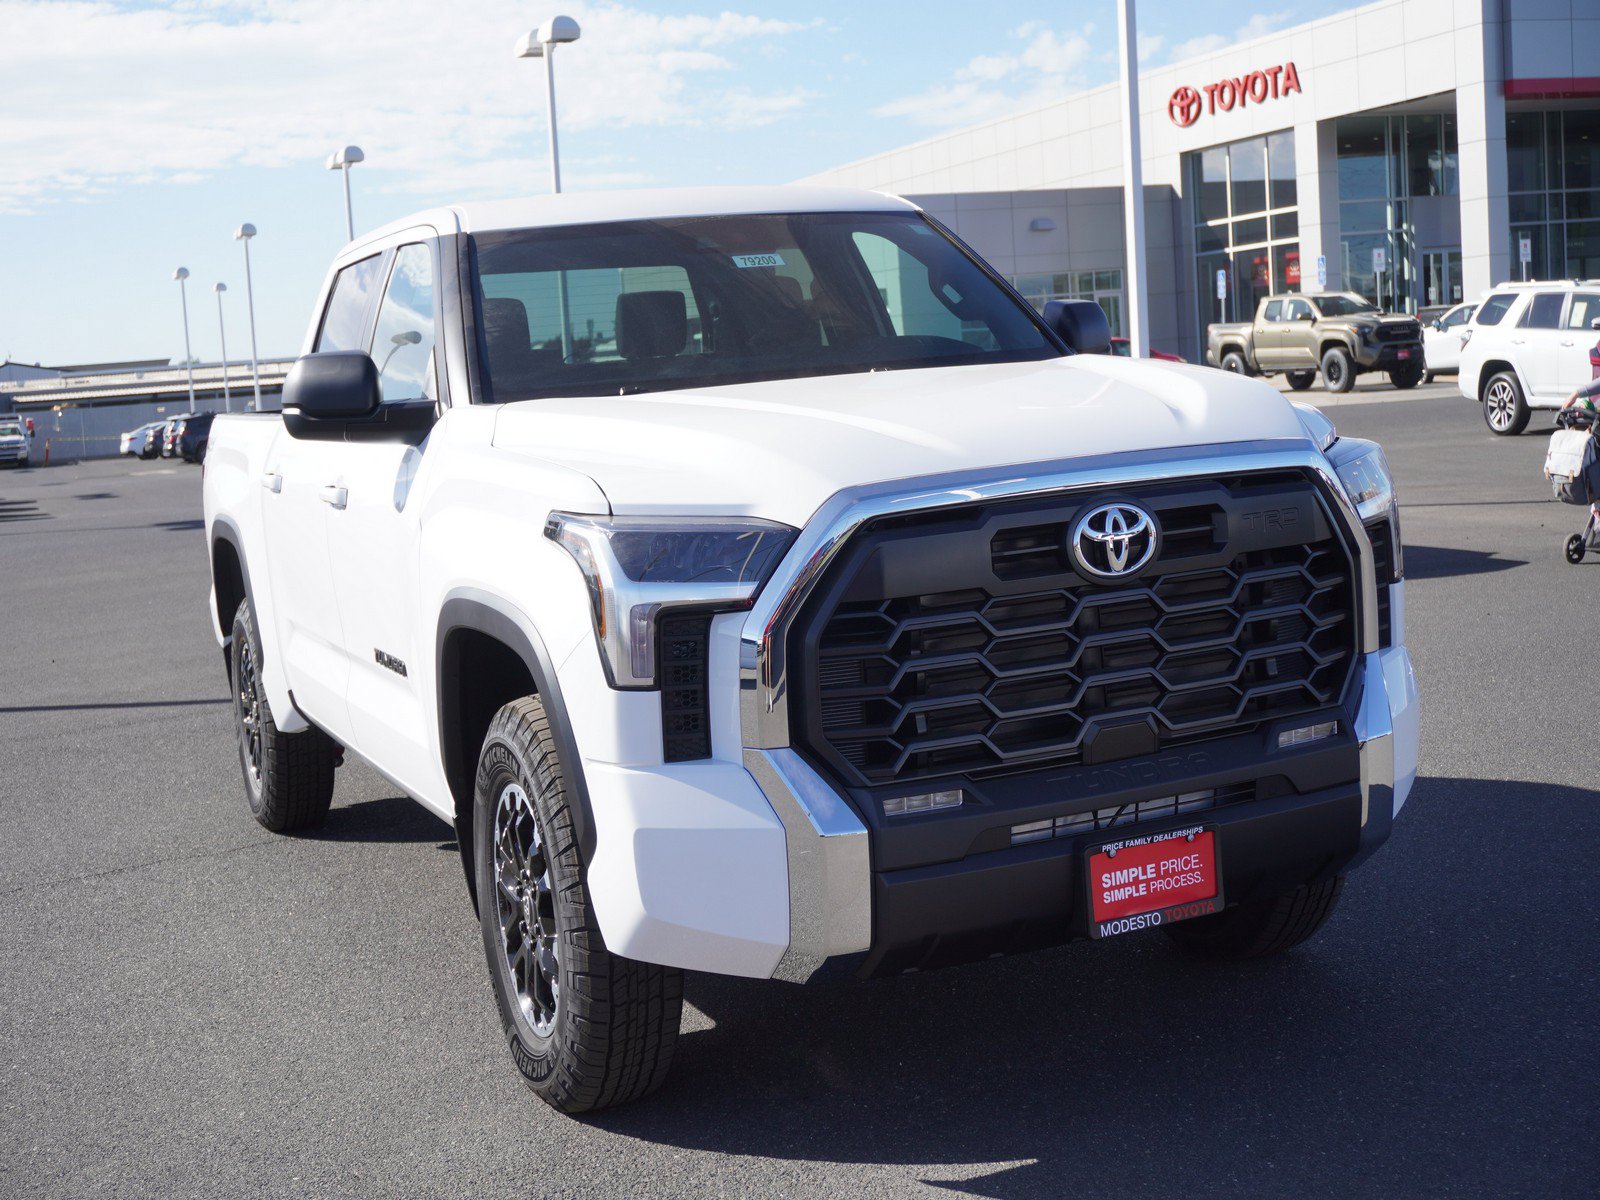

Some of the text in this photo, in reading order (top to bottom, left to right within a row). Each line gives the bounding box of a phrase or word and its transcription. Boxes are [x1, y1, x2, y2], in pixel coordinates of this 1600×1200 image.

[1203, 62, 1301, 115] TOYOTA
[740, 256, 776, 266] 79200
[1242, 506, 1299, 533] TRD
[374, 648, 408, 678] TUNDRA
[485, 746, 519, 778] MICHELIN
[1102, 826, 1204, 853] PRICE FAMILY DEALERSHIPS
[1102, 854, 1203, 888] SIMPLE PRICE.
[1103, 871, 1204, 904] SIMPLE PROCESS.
[1100, 901, 1215, 938] MODESTO TOYOTA
[511, 1040, 549, 1079] MICHELIN
